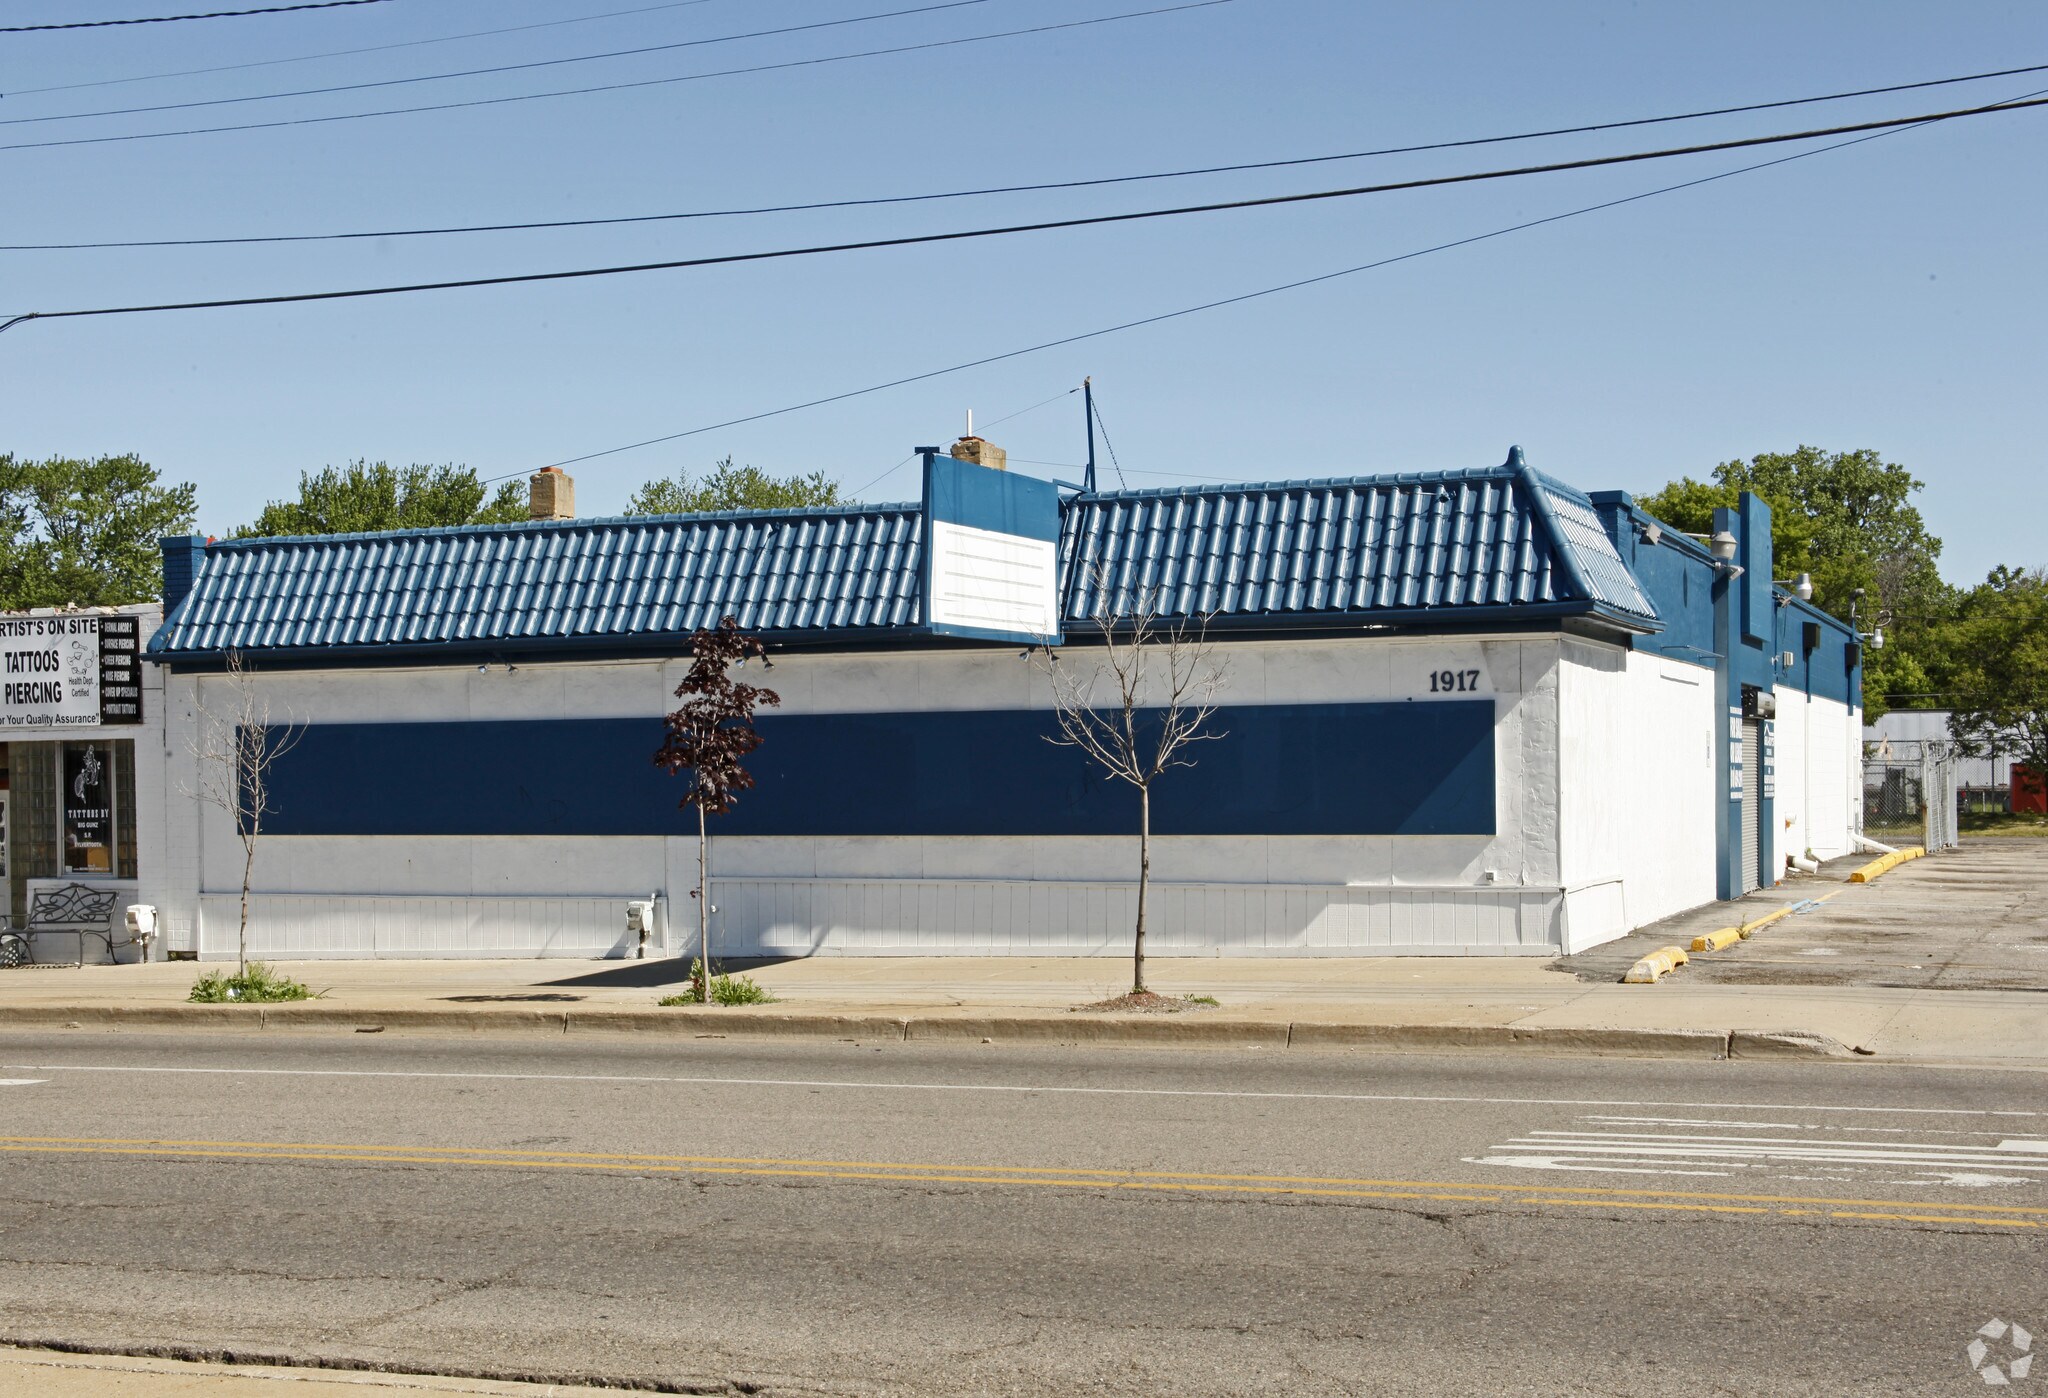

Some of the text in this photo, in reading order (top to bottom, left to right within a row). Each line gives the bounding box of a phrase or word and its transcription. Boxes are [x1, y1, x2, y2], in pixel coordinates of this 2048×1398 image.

[48, 619, 65, 635] ON
[69, 618, 97, 634] SITE
[5, 650, 59, 673] TATTOOS
[1429, 669, 1480, 692] 1917
[5, 681, 62, 705] PIERCING
[72, 688, 89, 697] Certified
[7, 714, 24, 725] Your
[26, 713, 53, 726] Quality
[68, 809, 109, 818] TATTOOS BY
